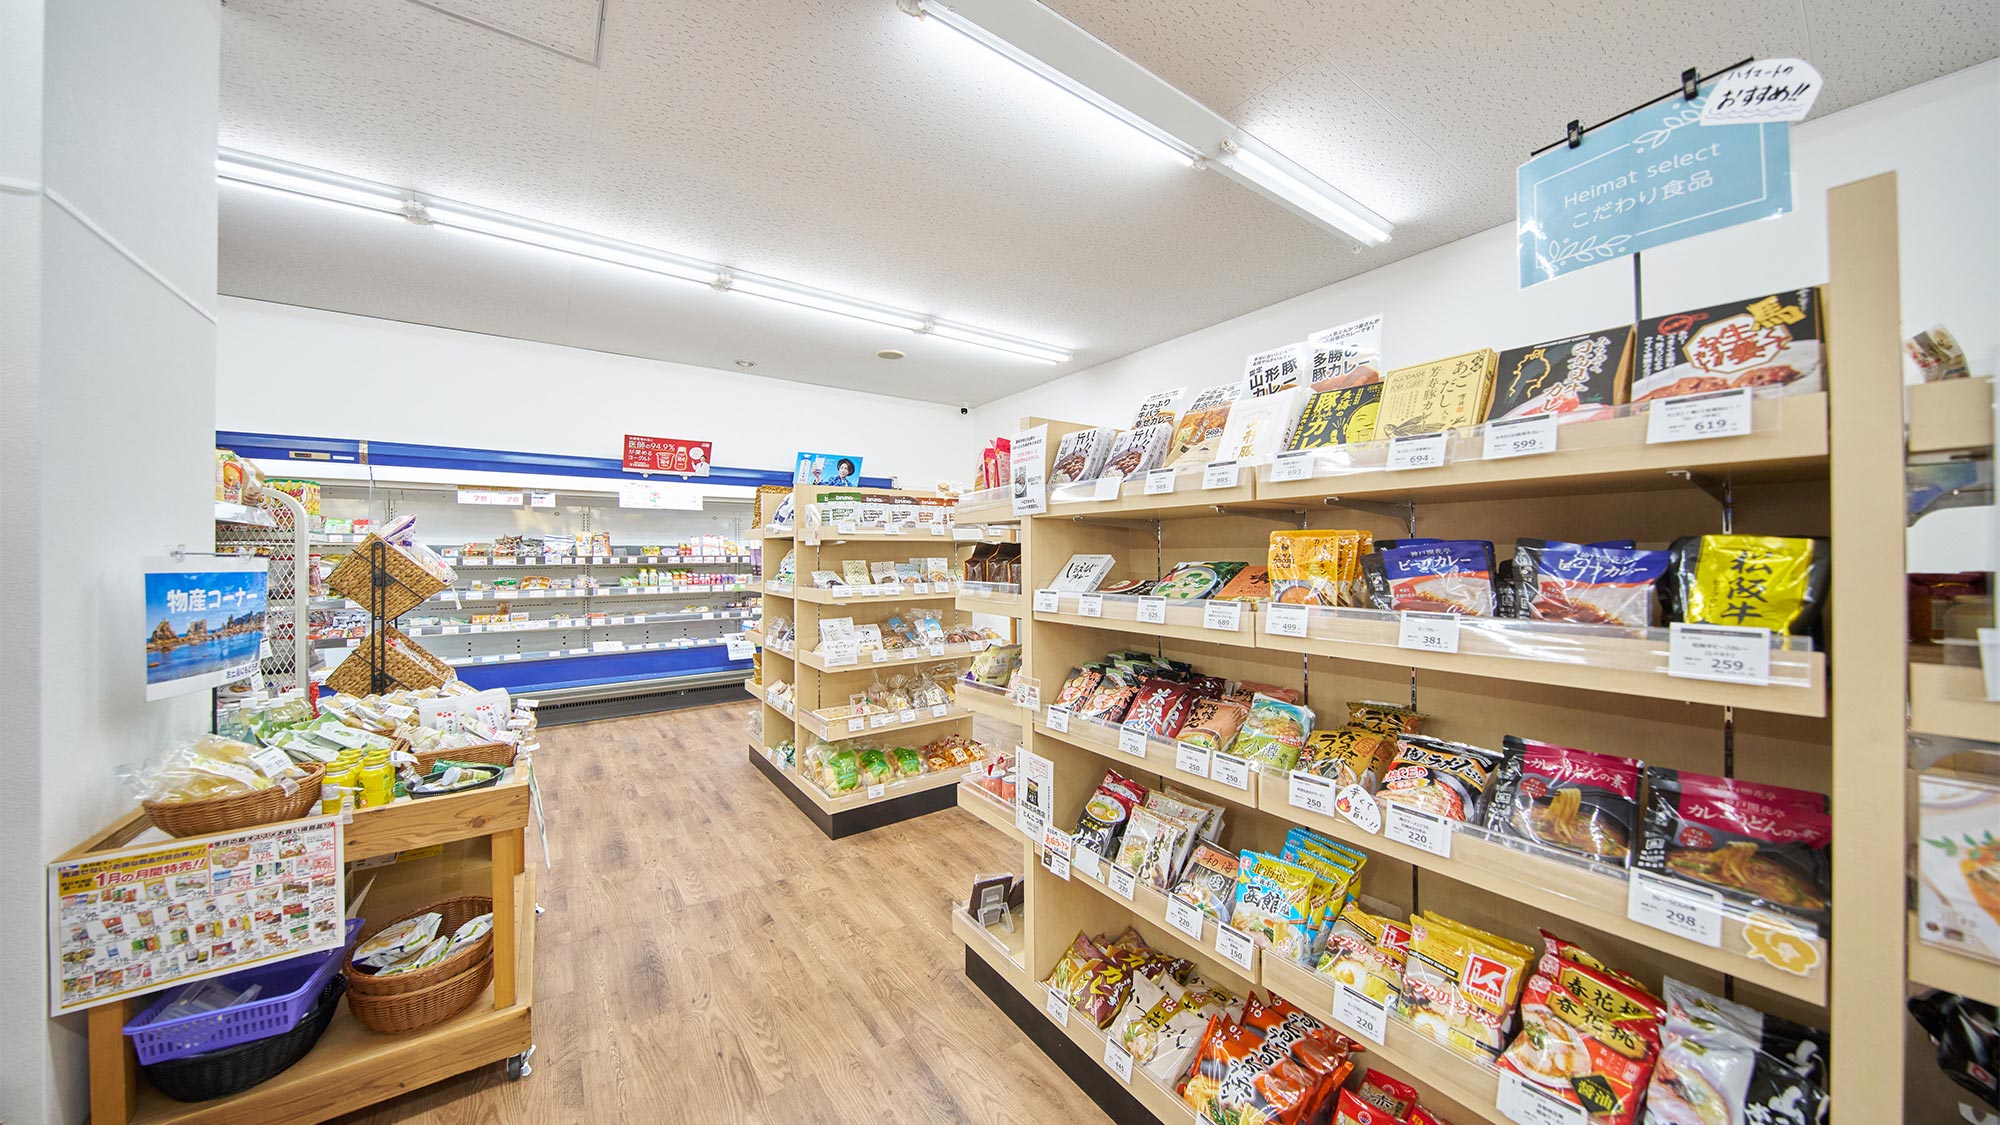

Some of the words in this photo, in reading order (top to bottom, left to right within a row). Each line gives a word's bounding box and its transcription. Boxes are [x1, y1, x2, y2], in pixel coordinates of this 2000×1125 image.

[1728, 65, 1794, 81] ハイマートの
[1717, 83, 1811, 110] おすすめ!!
[1564, 171, 1637, 209] Heimat
[1647, 142, 1721, 178] select
[1571, 170, 1713, 229] こだわり食品
[1250, 357, 1298, 390] 山形豚
[1311, 360, 1370, 382] 豚カレー
[1140, 399, 1171, 411] たっぷり
[1135, 416, 1173, 428] 幸せカレー
[1694, 419, 1727, 431] 619
[1512, 438, 1537, 450] 599
[1409, 454, 1429, 464] 694
[1720, 550, 1774, 626] 松阪牛
[166, 587, 258, 614] 物産コーナー
[1282, 623, 1297, 631] 499
[1423, 636, 1442, 645] 381
[1711, 658, 1744, 671] 259
[1189, 762, 1201, 772] 250
[1225, 773, 1239, 783] 250
[1306, 798, 1322, 808] 250
[1408, 831, 1428, 844] 220
[95, 858, 206, 887] 1月の月間特売!!
[1178, 916, 1190, 928] 220
[1665, 910, 1697, 927] 298
[1230, 948, 1243, 960] 150
[1356, 1015, 1374, 1031] 220
